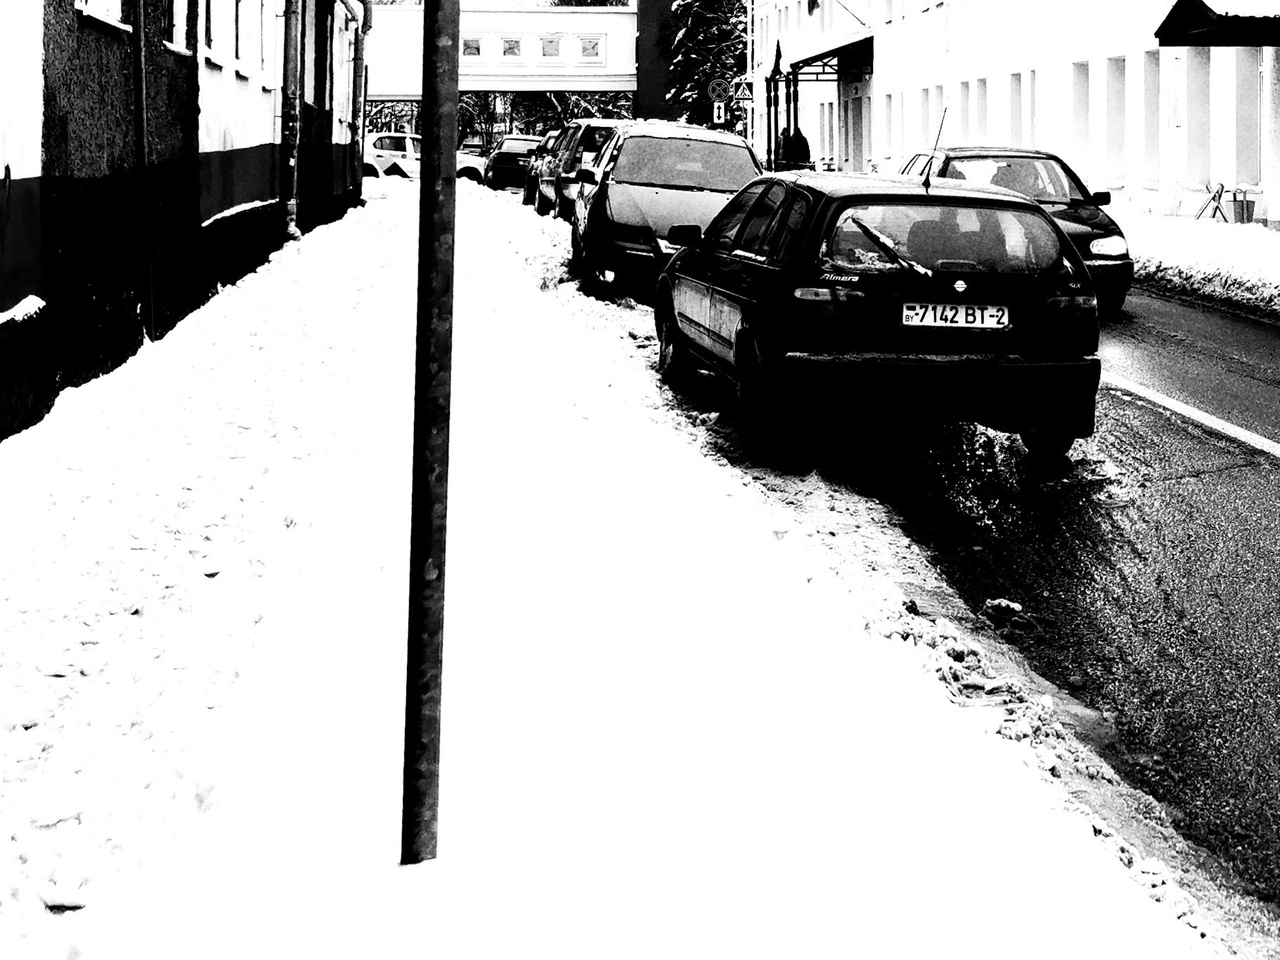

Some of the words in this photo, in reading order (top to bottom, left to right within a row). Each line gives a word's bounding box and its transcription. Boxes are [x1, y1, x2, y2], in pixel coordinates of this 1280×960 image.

[819, 273, 860, 281] Almera
[905, 314, 915, 322] BY
[919, 304, 959, 324] 7142
